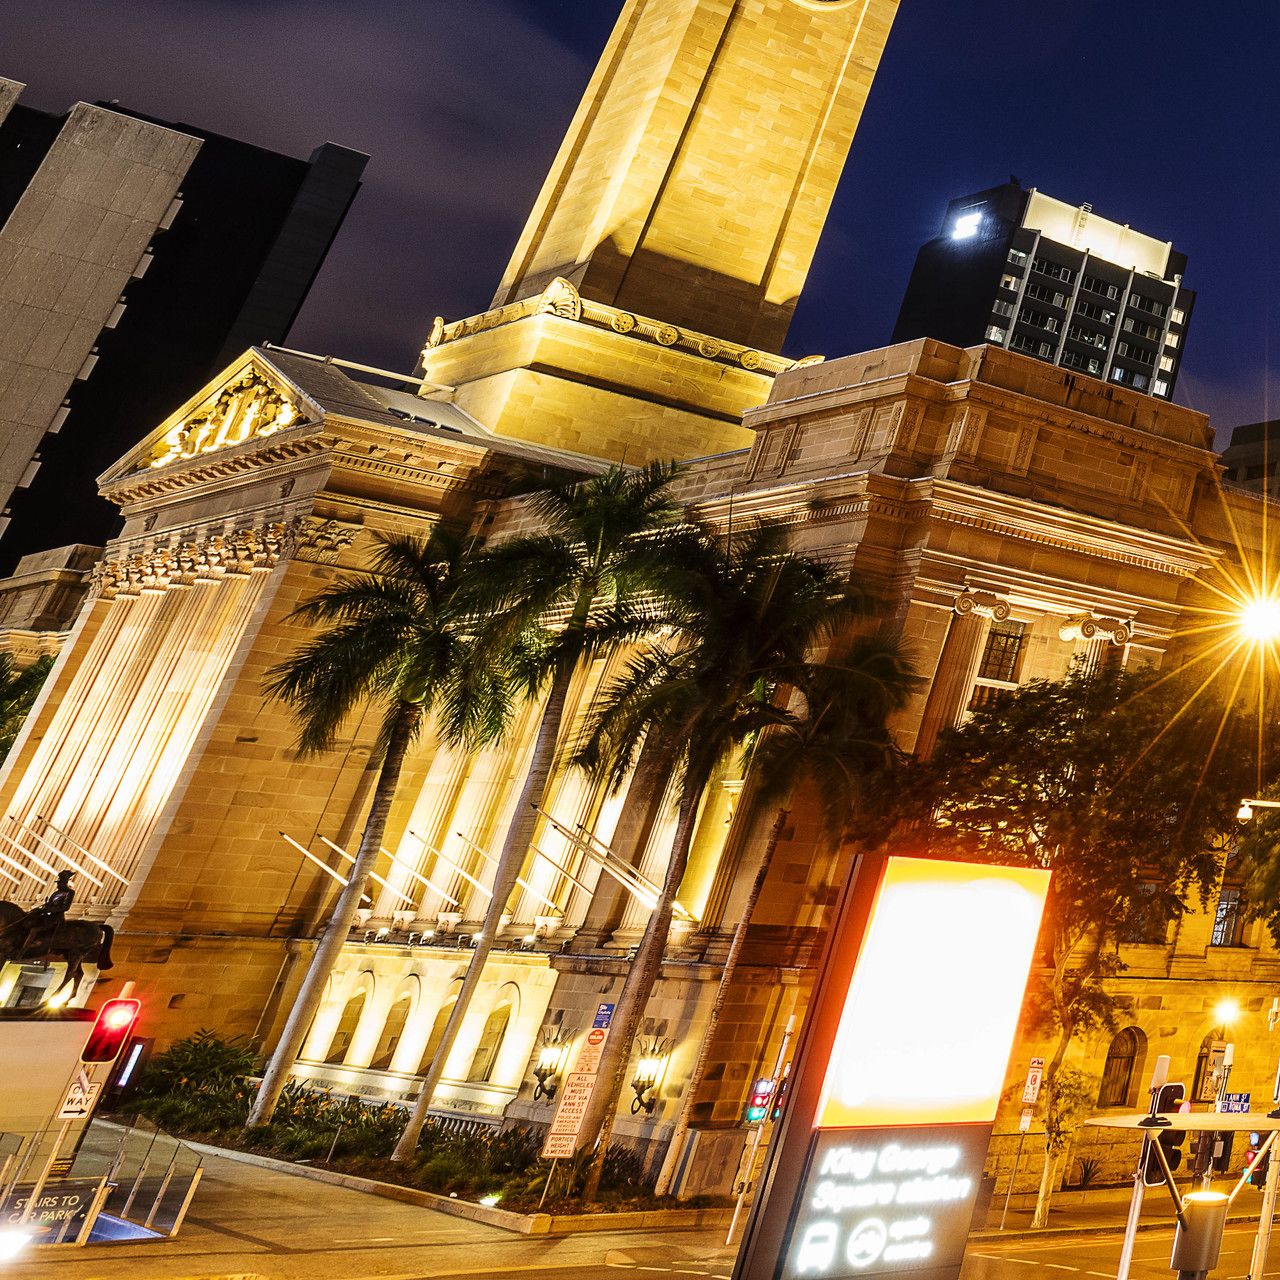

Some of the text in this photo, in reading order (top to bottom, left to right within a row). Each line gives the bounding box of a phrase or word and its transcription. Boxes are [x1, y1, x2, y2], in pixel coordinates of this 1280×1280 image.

[73, 1086, 95, 1095] OE
[66, 1097, 92, 1106] WAY
[820, 1147, 877, 1179] King
[62, 1195, 80, 1207] TO
[40, 1209, 75, 1222] PARK
